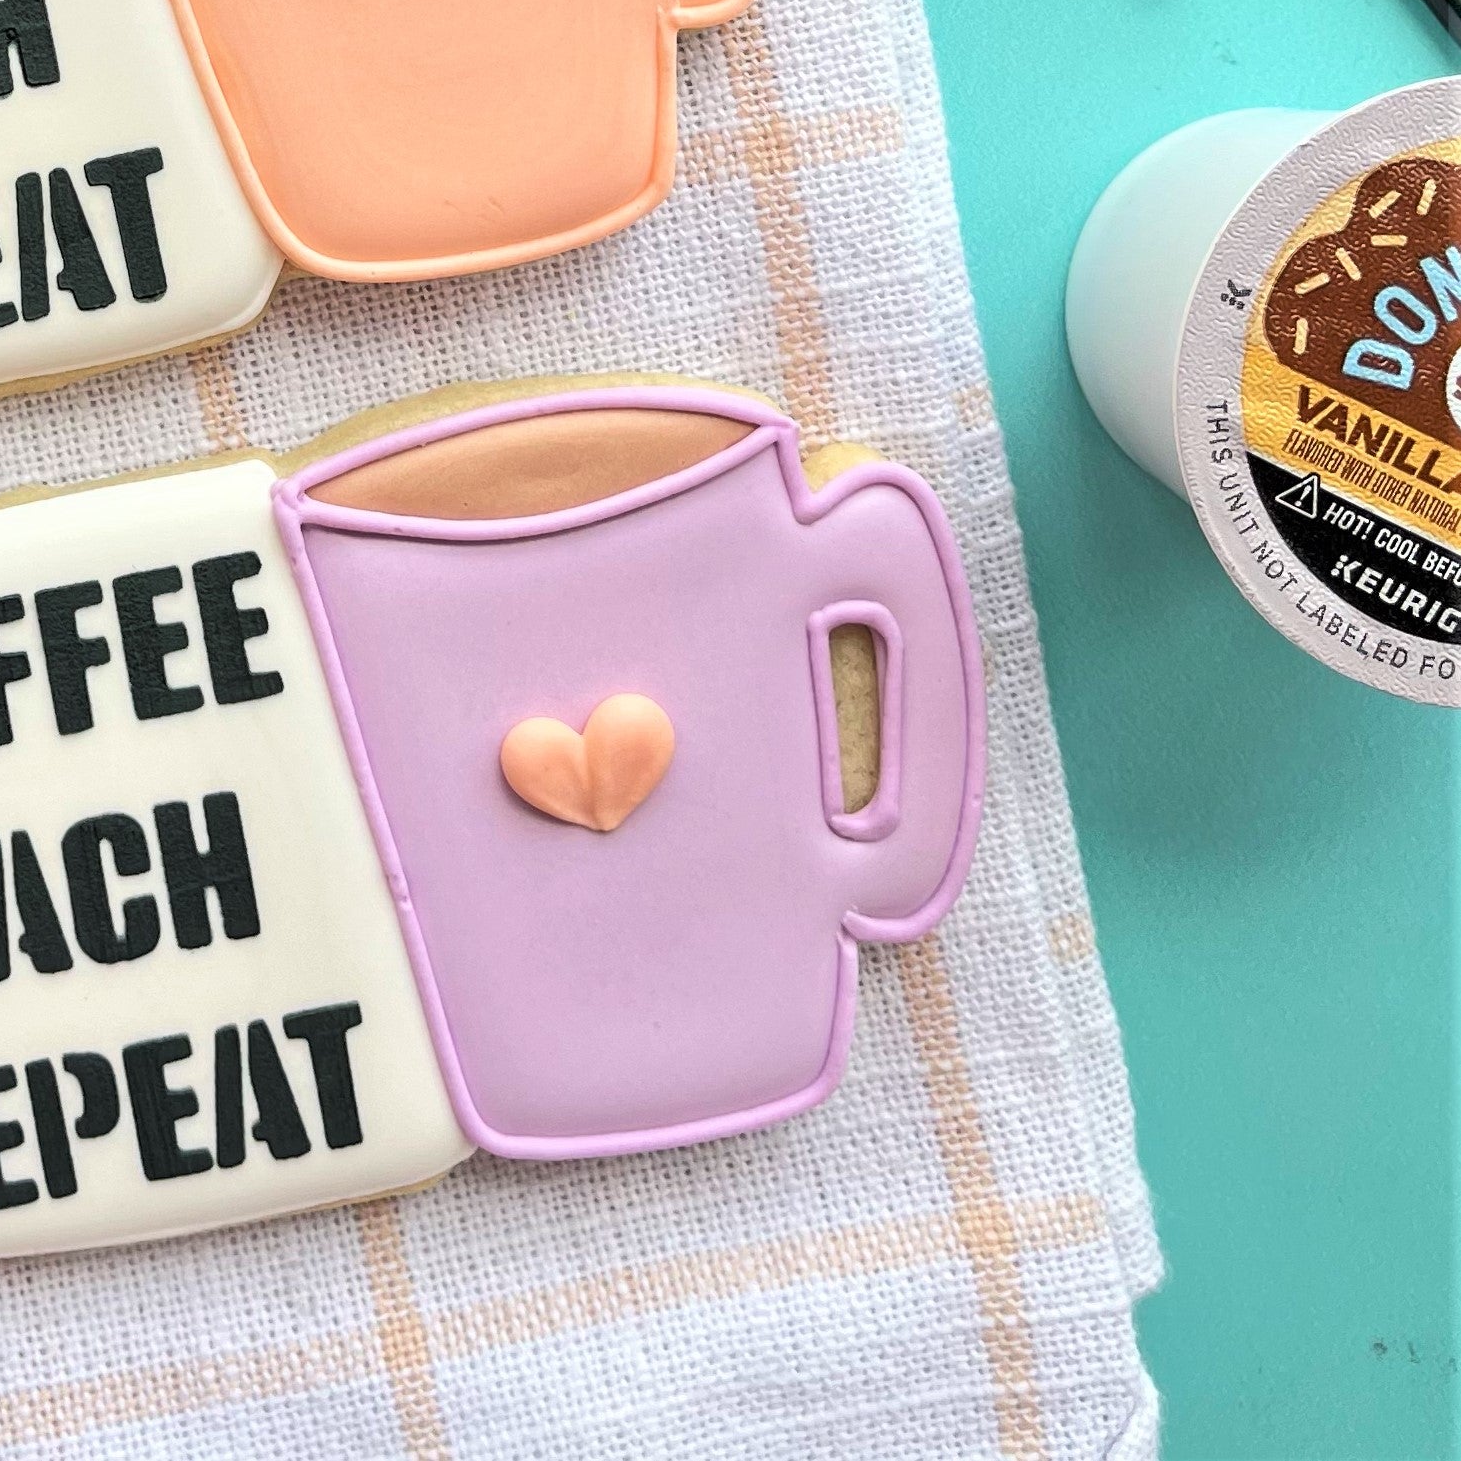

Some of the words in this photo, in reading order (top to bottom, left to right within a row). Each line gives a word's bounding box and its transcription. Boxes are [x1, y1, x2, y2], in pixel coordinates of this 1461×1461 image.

[1206, 400, 1233, 464] THIS
[1281, 428, 1346, 474] FLAVORED
[1340, 454, 1377, 490] WITH
[1373, 471, 1413, 508] OTHER
[1219, 472, 1260, 535] UNIT
[1322, 501, 1375, 540] HOT!
[1374, 527, 1420, 566] COOL
[1251, 539, 1298, 592] NOT
[1295, 590, 1408, 669] LABELED
